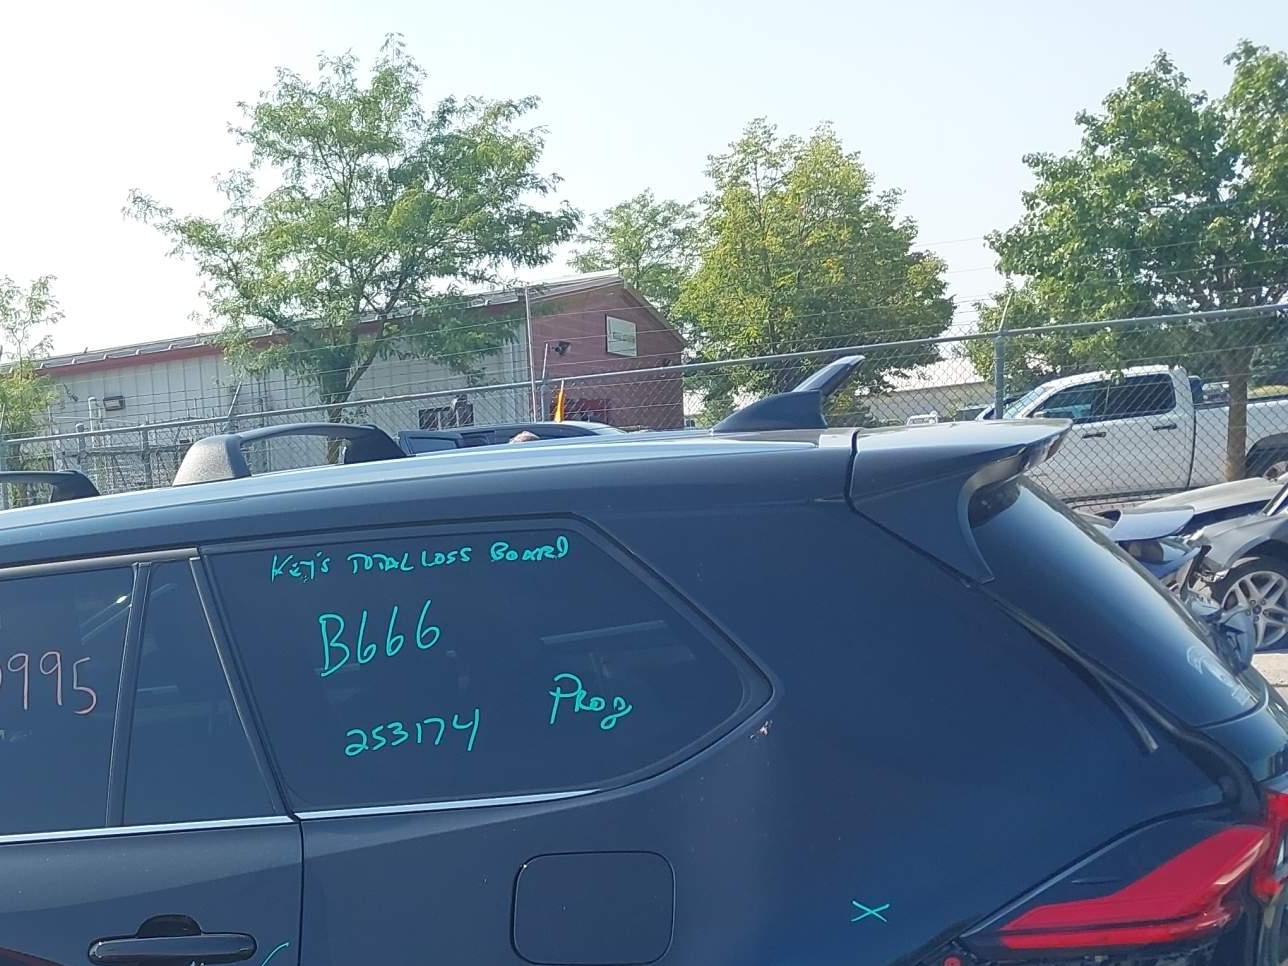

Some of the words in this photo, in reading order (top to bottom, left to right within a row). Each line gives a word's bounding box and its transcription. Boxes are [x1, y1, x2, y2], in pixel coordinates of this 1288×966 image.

[421, 546, 472, 567] LOSS
[319, 600, 440, 677] B666
[345, 709, 479, 756] 253174
